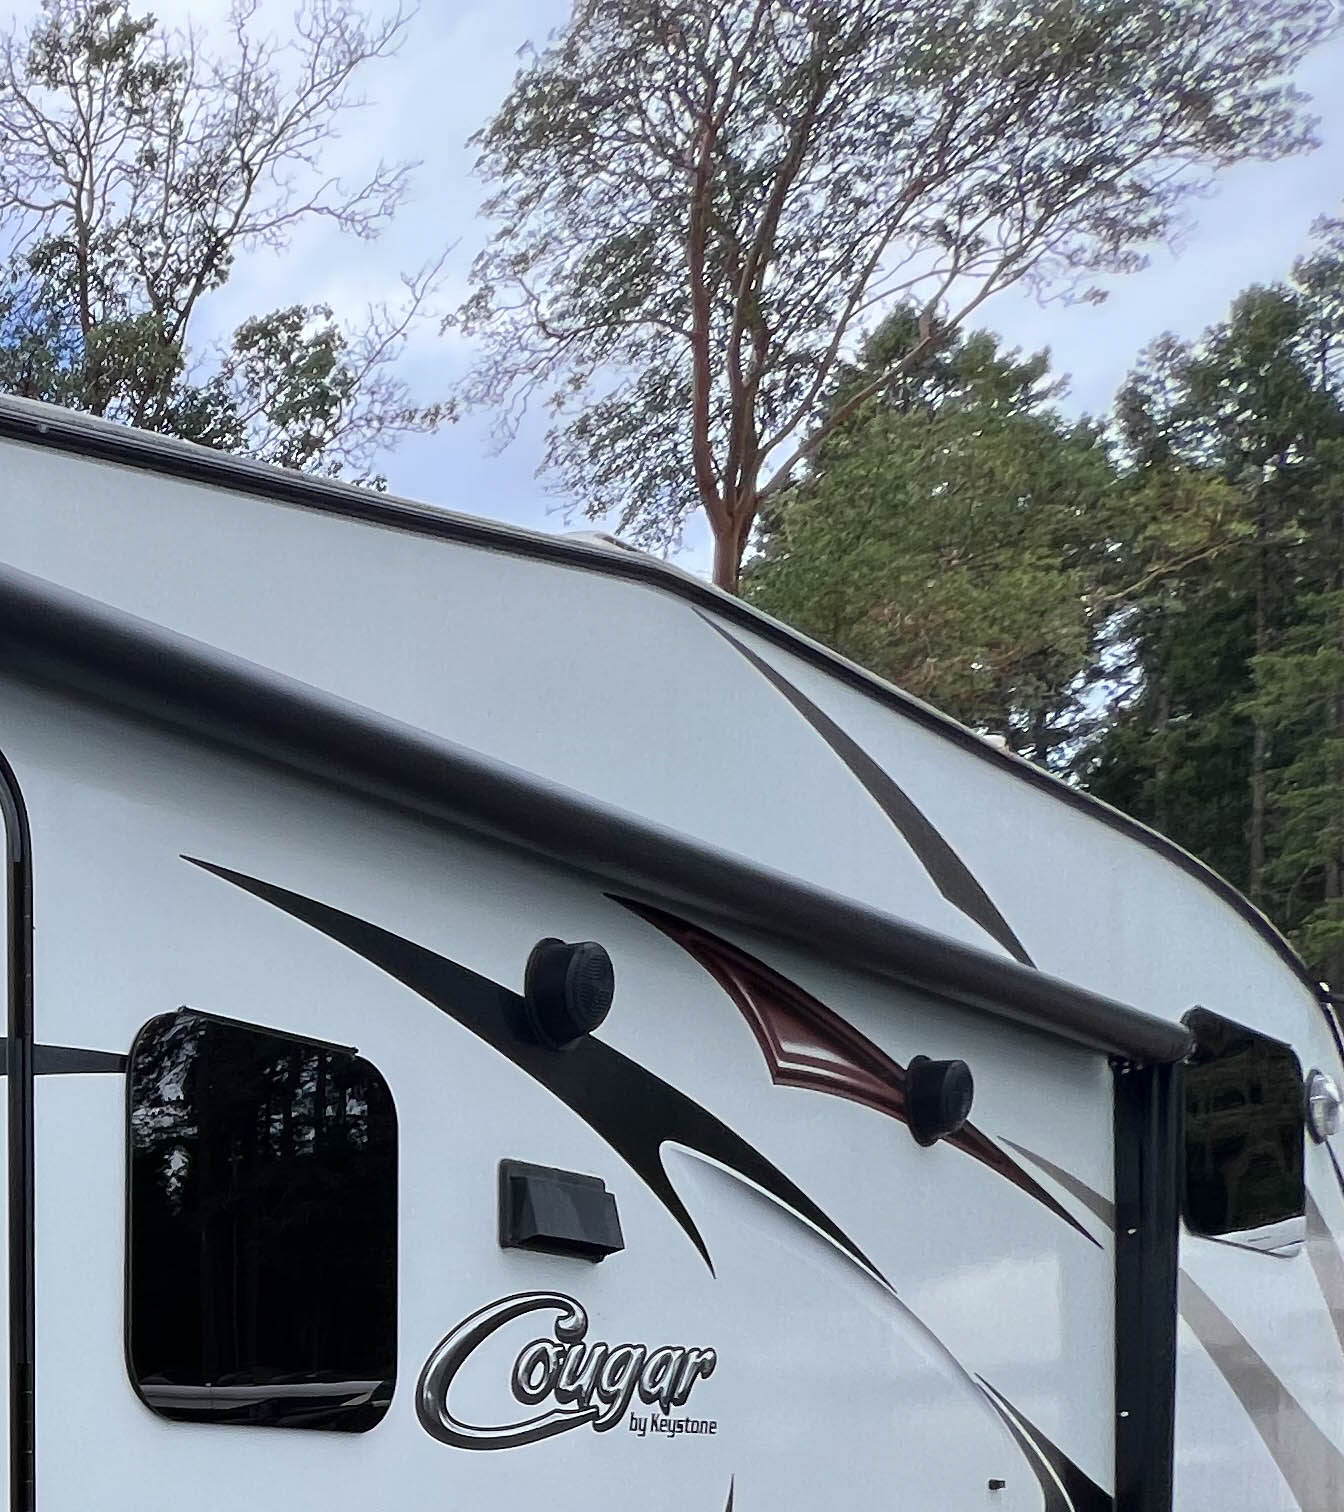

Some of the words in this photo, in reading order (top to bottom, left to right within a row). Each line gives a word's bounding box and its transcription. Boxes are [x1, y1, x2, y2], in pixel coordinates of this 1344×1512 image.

[415, 1291, 717, 1451] Cougar
[629, 1411, 648, 1437] by
[650, 1413, 718, 1438] Keystone
